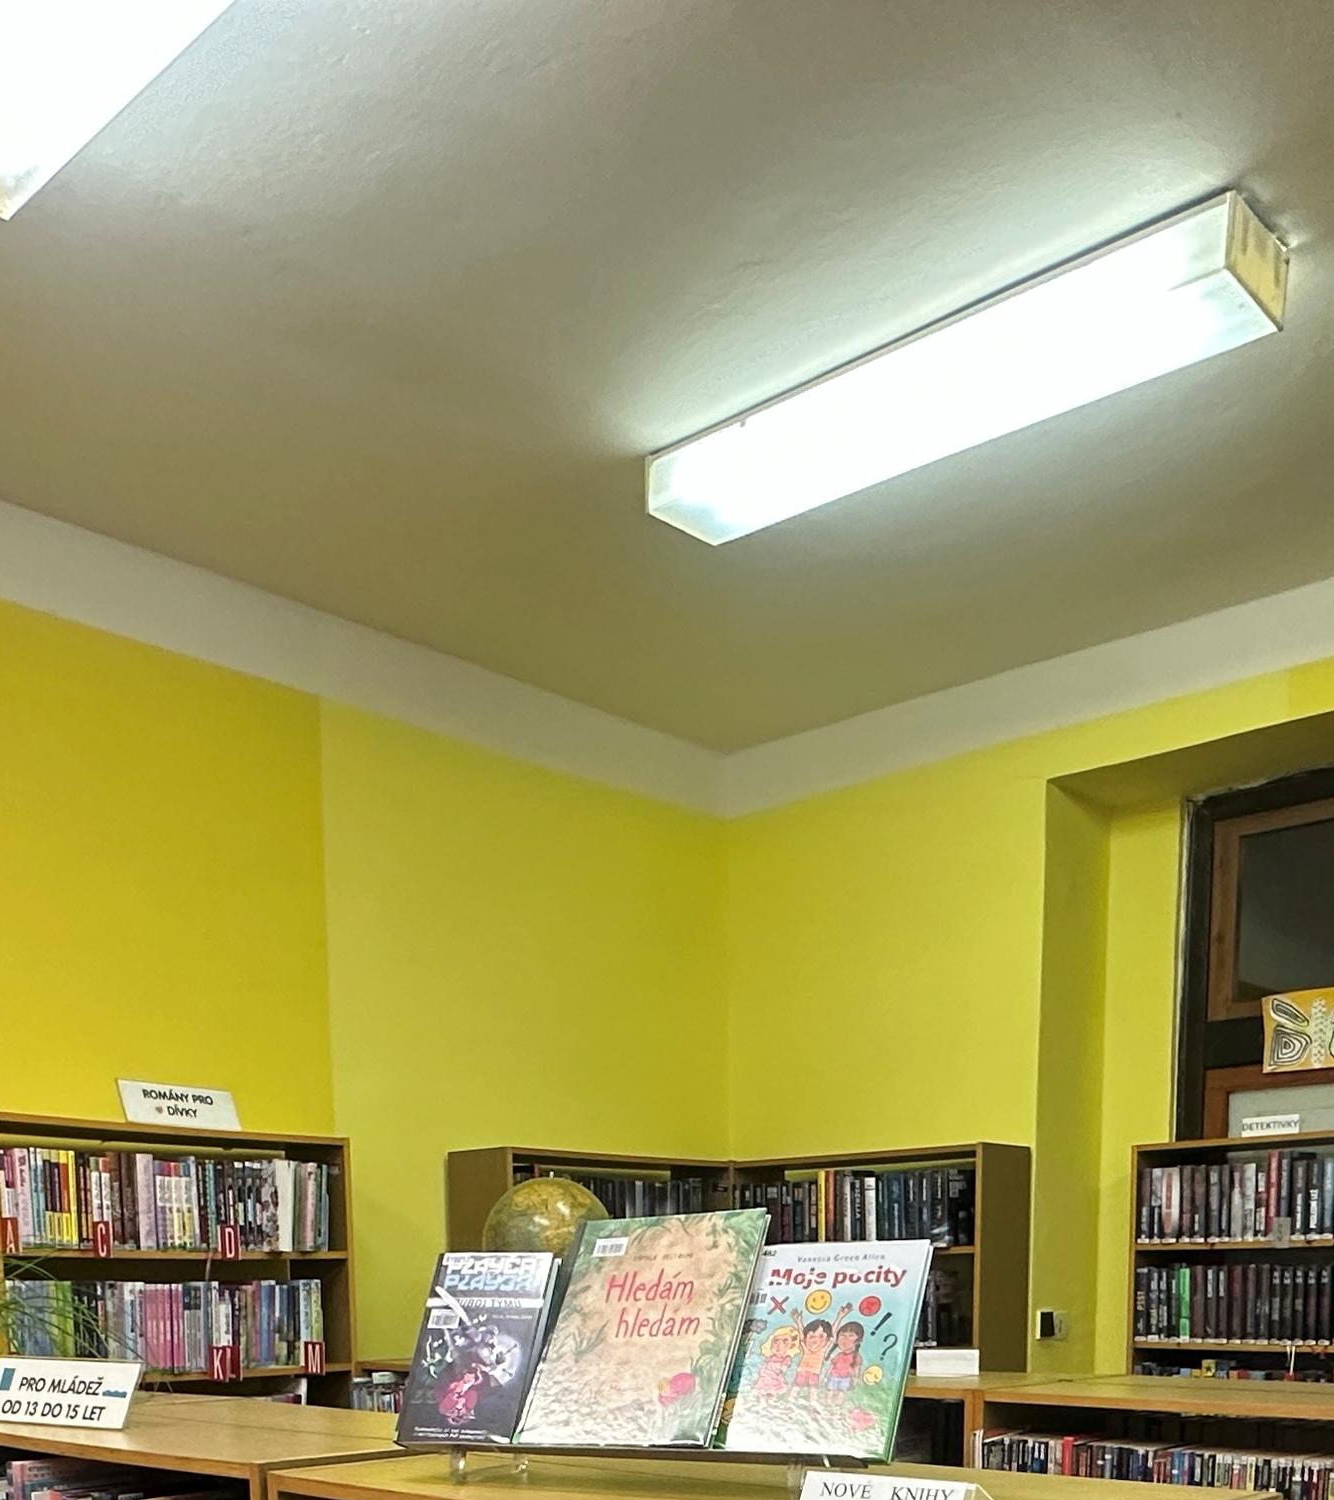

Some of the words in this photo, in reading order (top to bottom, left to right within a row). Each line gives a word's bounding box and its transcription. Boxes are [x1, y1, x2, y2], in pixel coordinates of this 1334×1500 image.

[142, 1088, 189, 1103] ROMÁNY
[191, 1092, 214, 1105] PRO
[167, 1104, 198, 1119] DÍVKY
[1242, 1120, 1299, 1132] DETEKTIVKY
[4, 1219, 16, 1253] A
[98, 1222, 108, 1257] C
[224, 1226, 237, 1258] D
[832, 1266, 907, 1288] pocity
[615, 1303, 700, 1338] hledám
[213, 1346, 223, 1378] K
[307, 1344, 323, 1373] M
[19, 1376, 45, 1393] PRO
[47, 1376, 103, 1397] MLÁDEŽ
[2, 1399, 22, 1416] OD
[24, 1400, 38, 1417] 13
[42, 1401, 63, 1419] DO
[66, 1403, 80, 1419] 15
[83, 1404, 107, 1422] LET
[820, 1481, 872, 1500] NOVÉ
